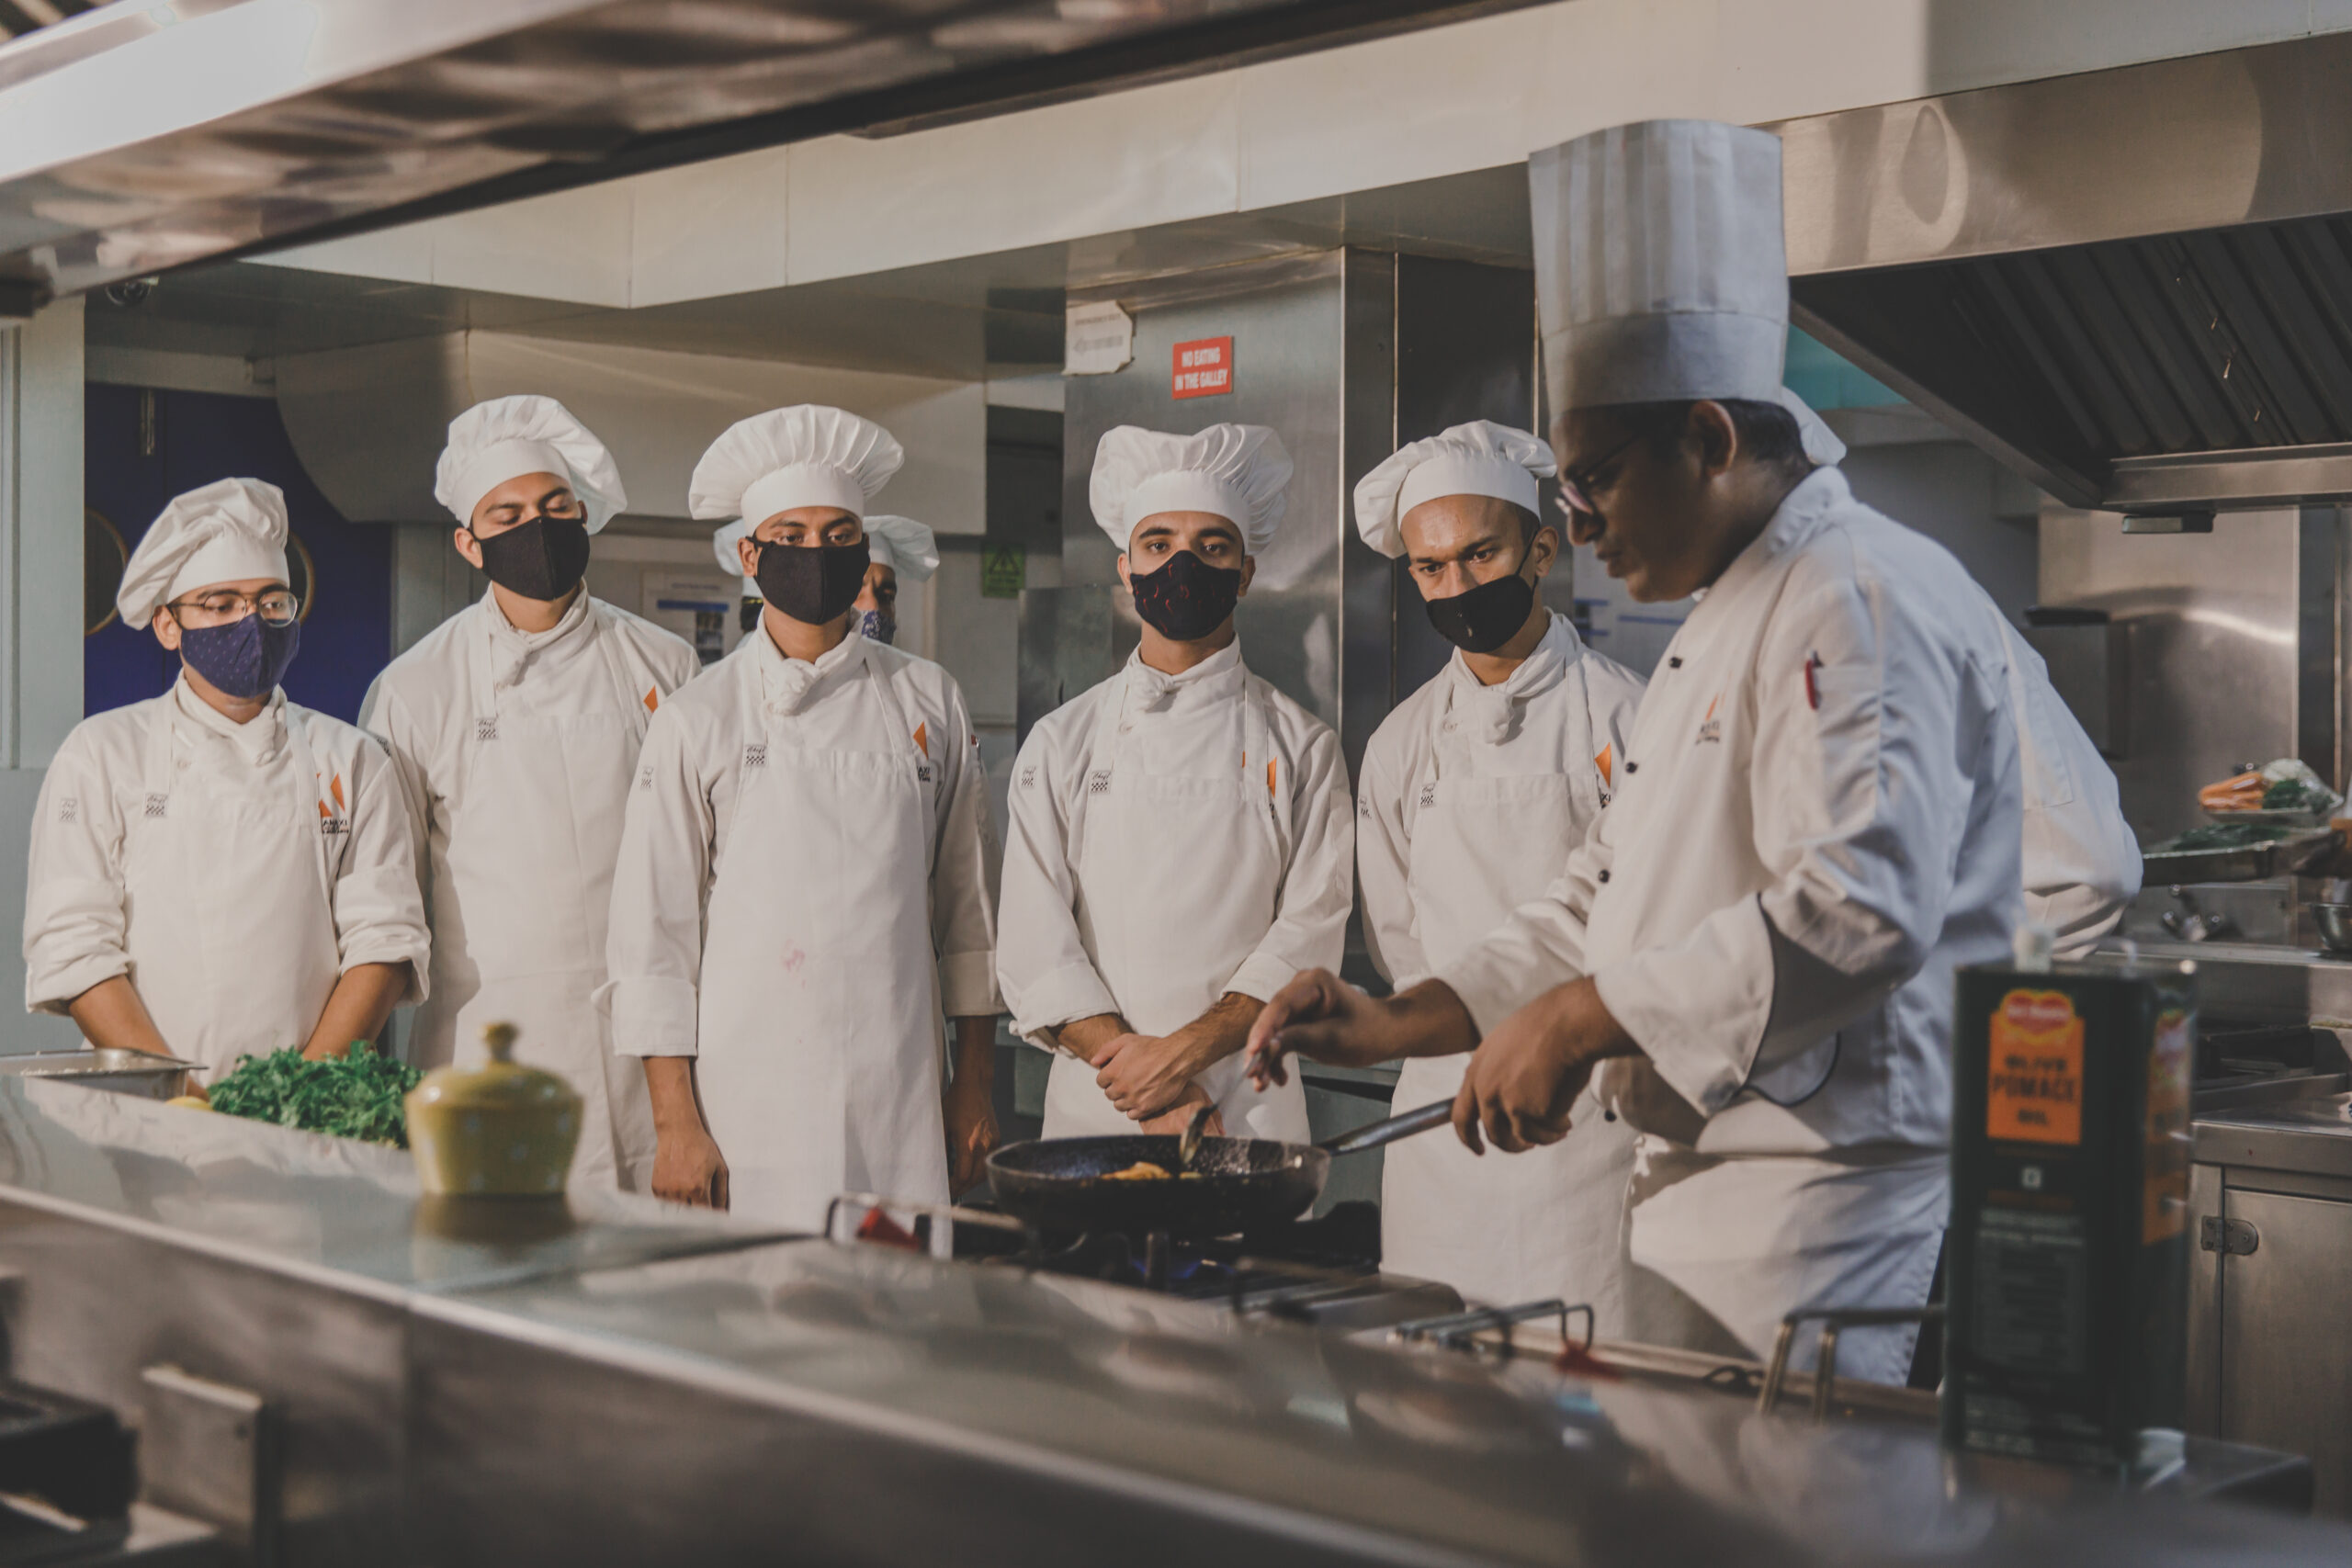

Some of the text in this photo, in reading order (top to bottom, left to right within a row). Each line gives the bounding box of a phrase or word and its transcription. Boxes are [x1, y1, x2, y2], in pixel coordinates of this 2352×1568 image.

[1182, 346, 1220, 367] NO EATING
[1174, 369, 1227, 391] IN THE GALLEY
